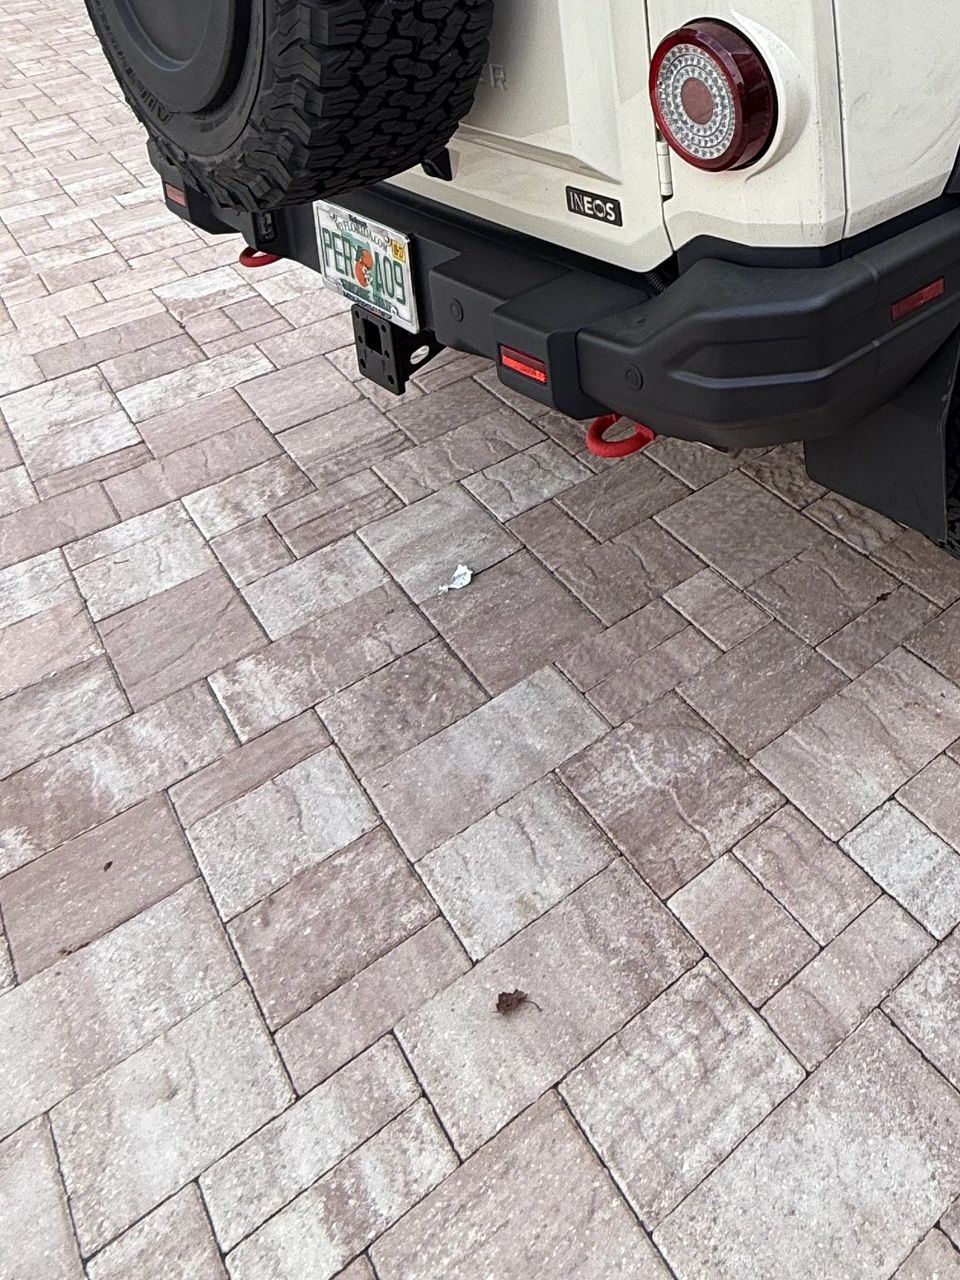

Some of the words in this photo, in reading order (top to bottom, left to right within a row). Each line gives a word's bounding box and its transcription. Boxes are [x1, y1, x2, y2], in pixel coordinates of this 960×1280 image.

[569, 191, 615, 221] INEOS
[322, 227, 355, 279] PER
[373, 251, 406, 306] A09
